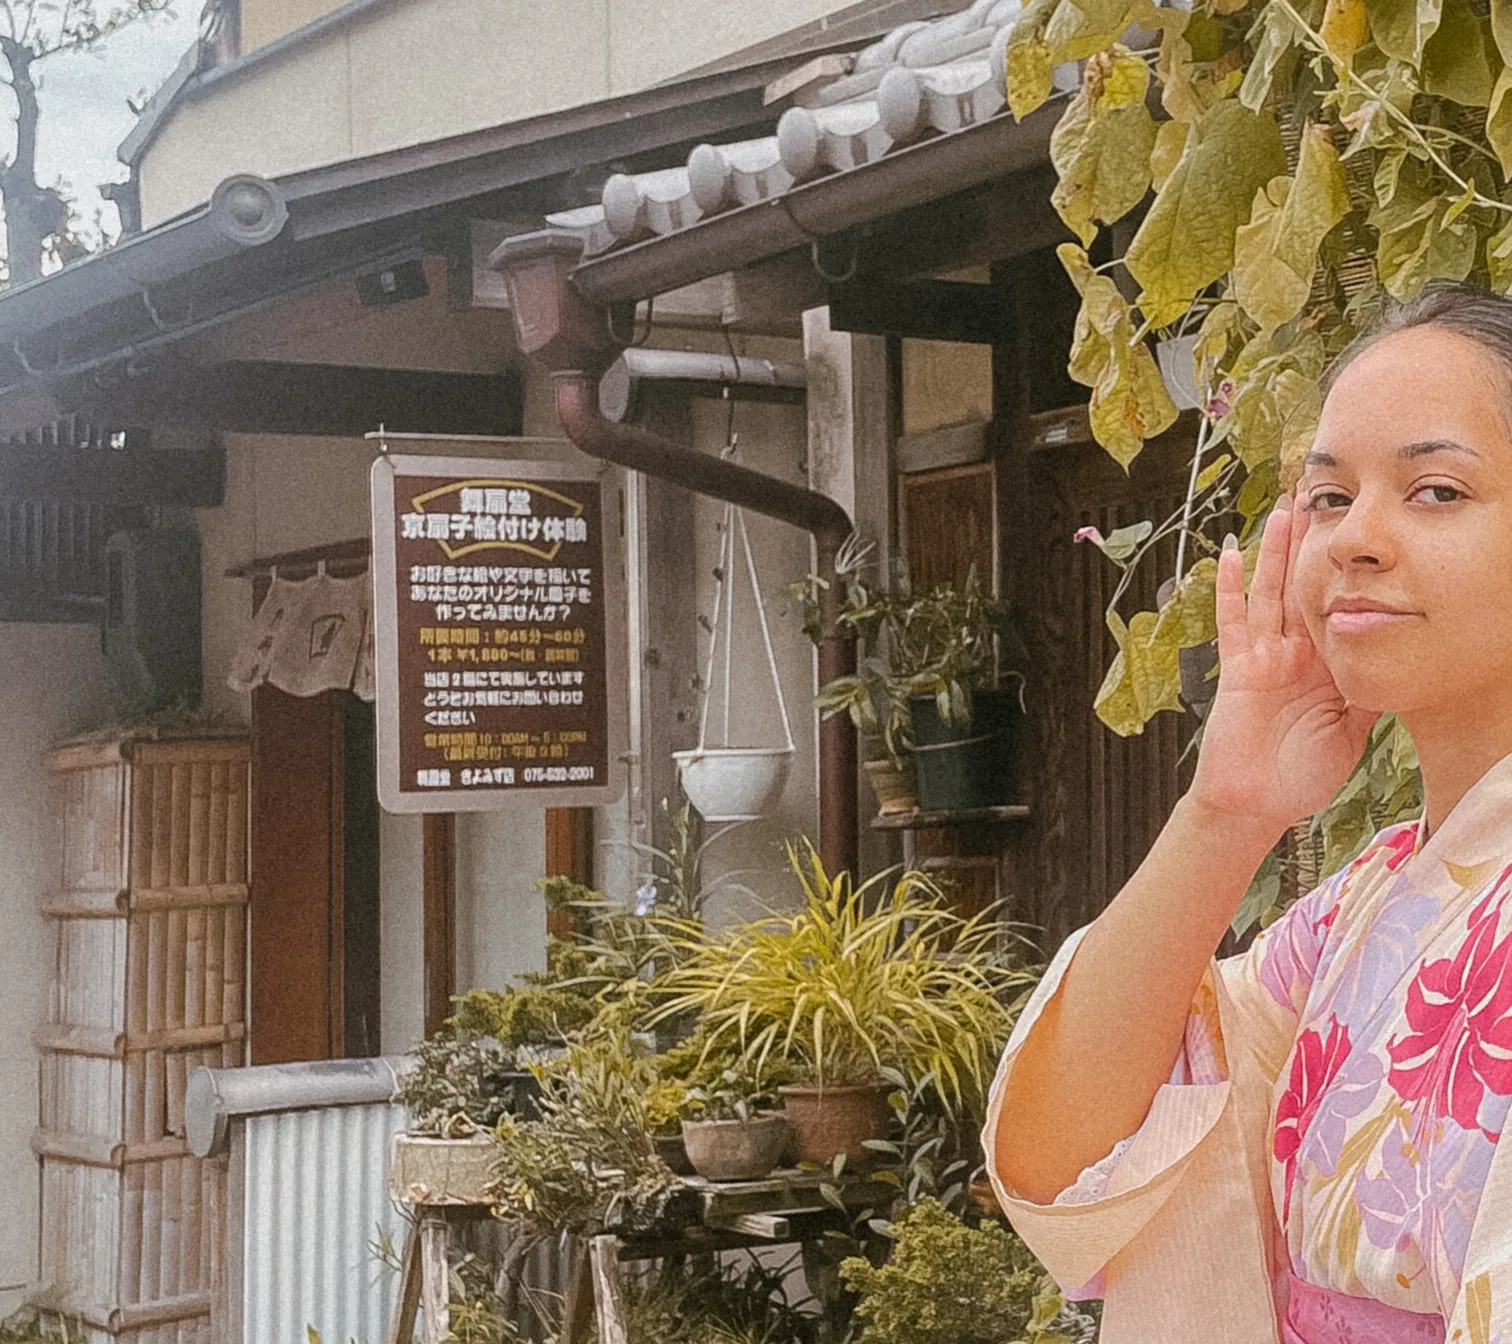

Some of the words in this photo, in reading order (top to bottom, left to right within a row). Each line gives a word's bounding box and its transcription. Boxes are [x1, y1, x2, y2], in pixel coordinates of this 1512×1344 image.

[401, 513, 588, 543] 京扇子絵付け体験
[410, 565, 591, 585] お好きな絵や文字を描いて
[410, 584, 591, 603] あなたのオリジナル扇子を
[424, 710, 476, 726] ください
